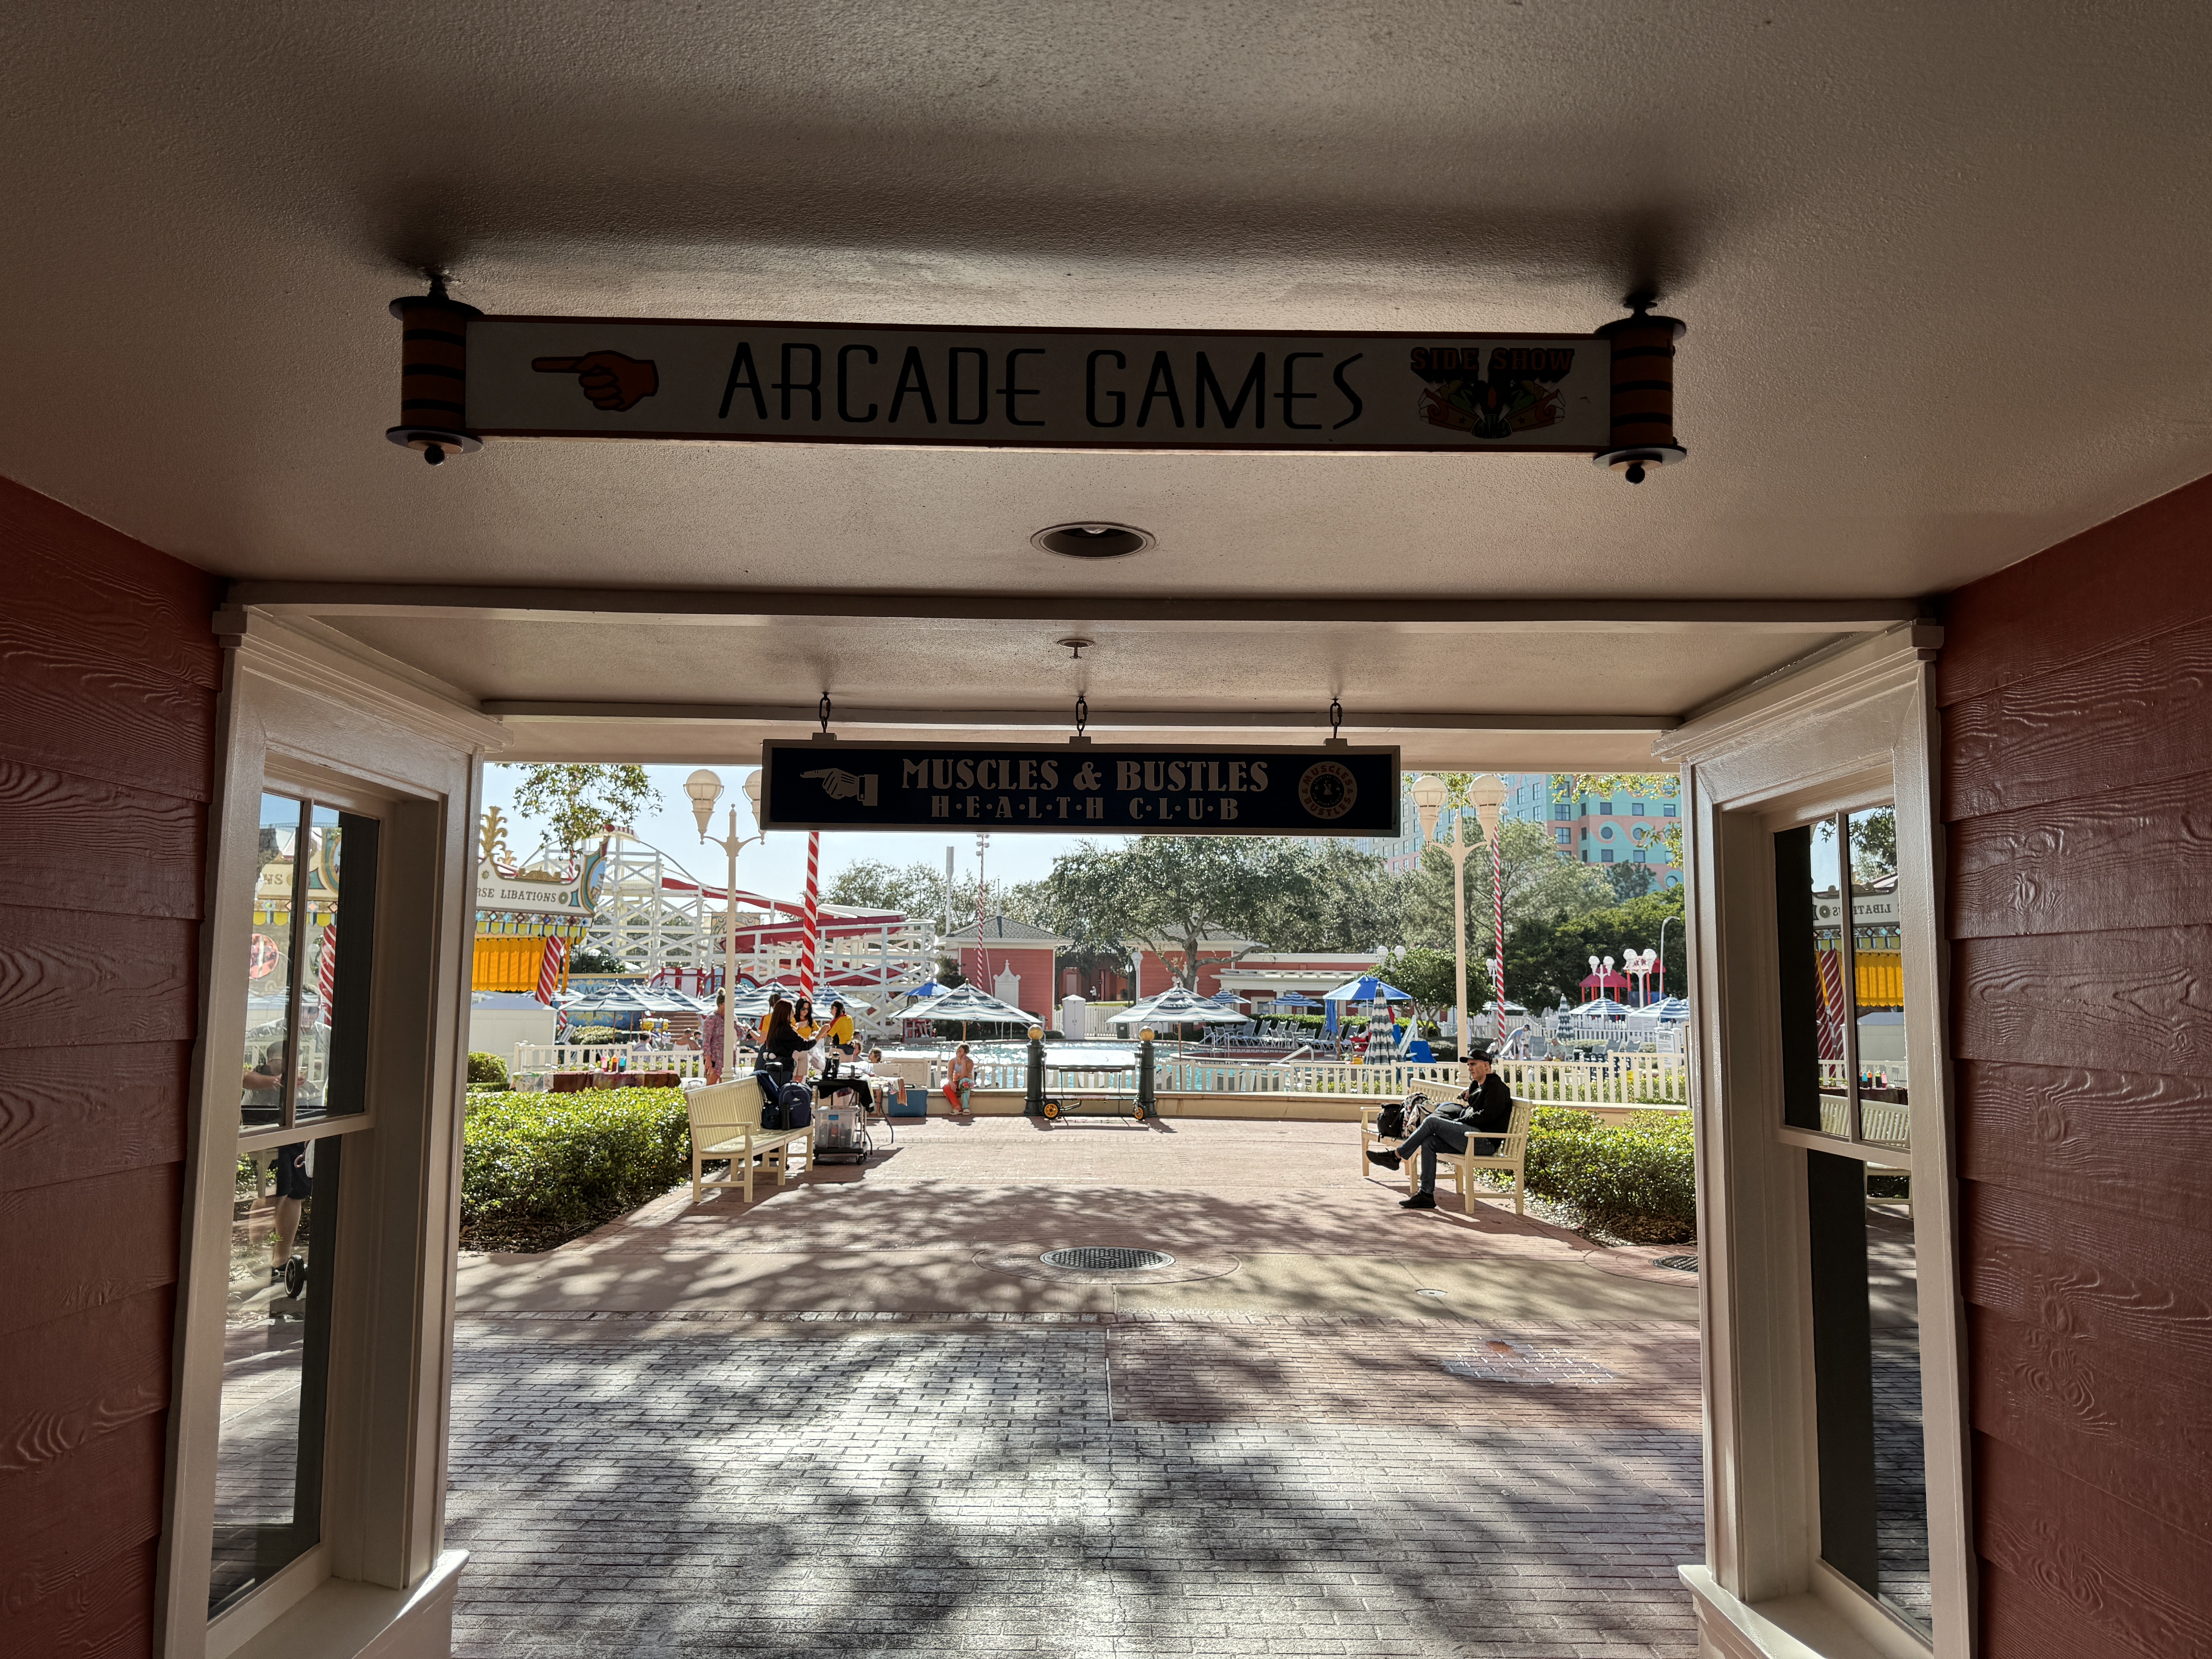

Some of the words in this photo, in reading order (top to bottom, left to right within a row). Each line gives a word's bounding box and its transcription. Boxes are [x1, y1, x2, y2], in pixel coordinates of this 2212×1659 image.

[1411, 347, 1479, 372] SIDE
[1492, 348, 1574, 372] SHOW
[718, 342, 1046, 426] ARCADE
[1086, 349, 1363, 430] GAMES
[902, 758, 1058, 790] MUSCLES
[1073, 761, 1102, 791] &
[1116, 761, 1268, 792] BUSTLES
[1303, 765, 1353, 786] MUSCLES
[1304, 796, 1351, 816] BUSTLES
[500, 889, 556, 902] LIBATIONS
